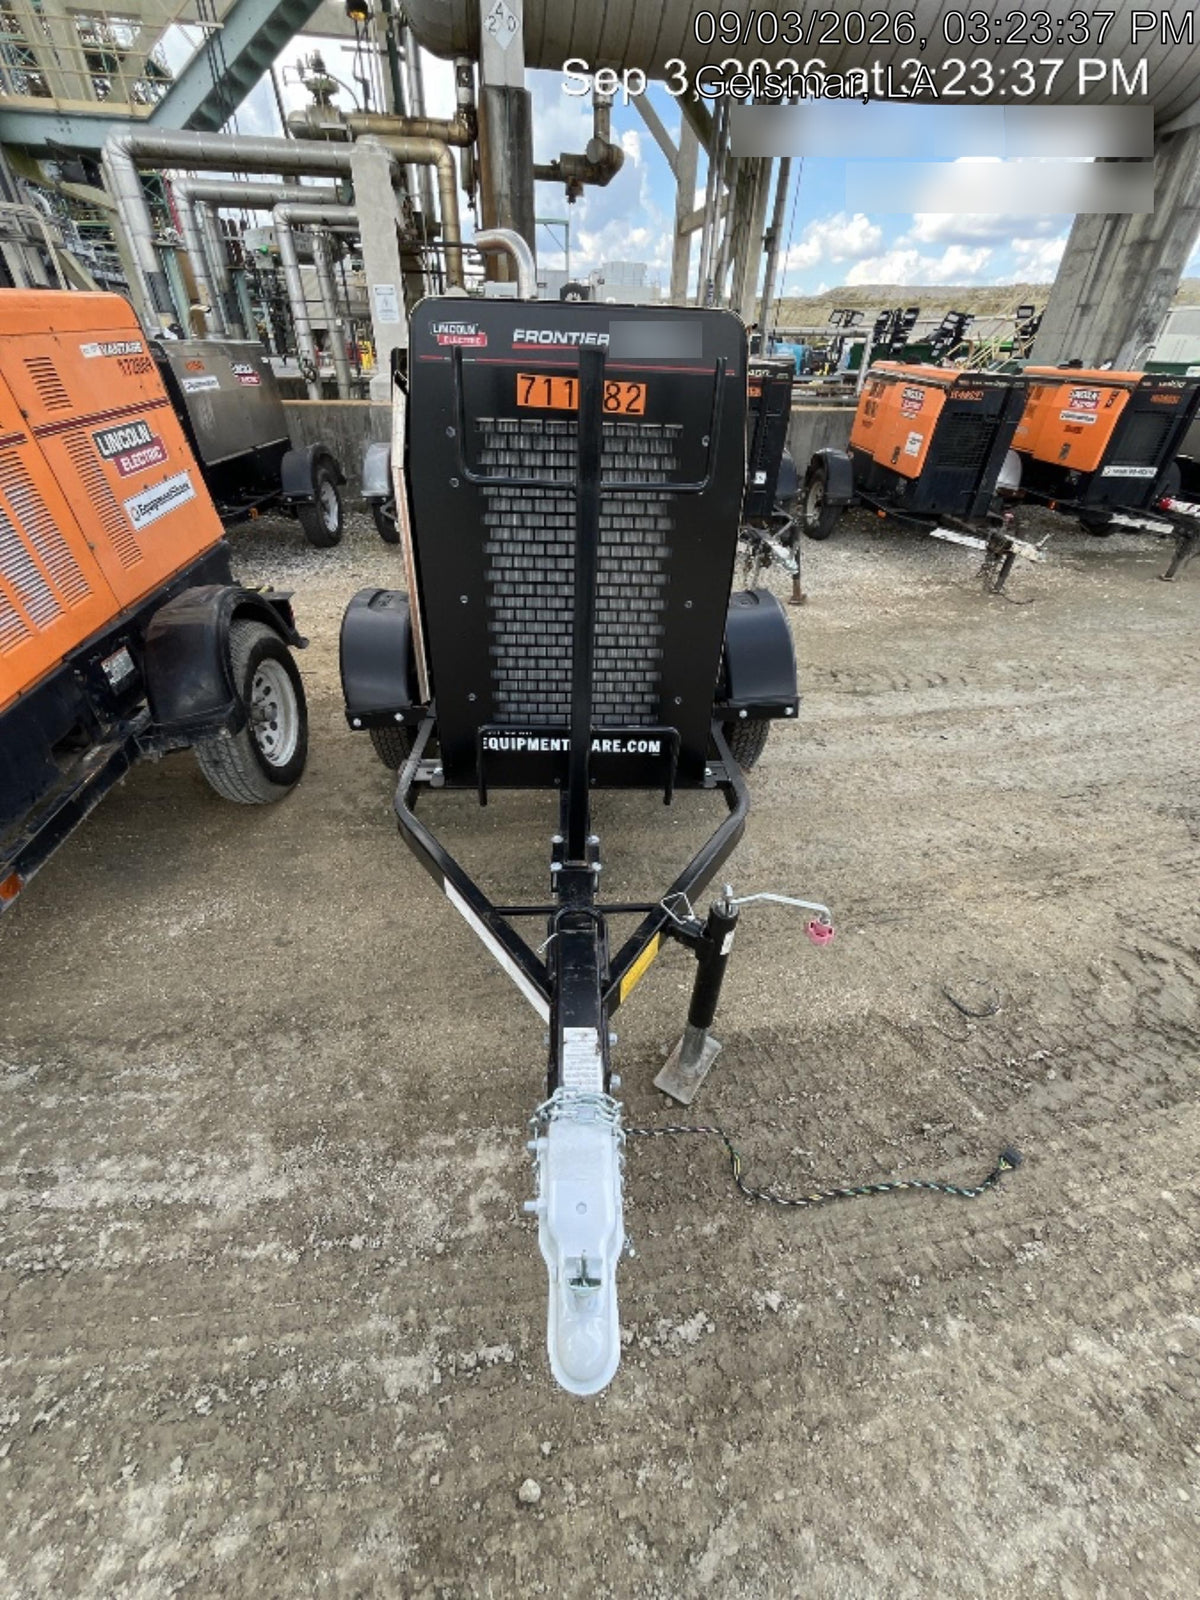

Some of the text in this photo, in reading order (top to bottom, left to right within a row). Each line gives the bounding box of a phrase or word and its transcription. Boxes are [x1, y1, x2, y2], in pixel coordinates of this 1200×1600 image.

[495, 2, 504, 19] 4
[488, 15, 517, 32] 2 0
[431, 322, 476, 335] LINCOLN
[512, 328, 610, 347] FRONTIER
[443, 335, 482, 345] ELECTRIC
[520, 376, 642, 412] 71182
[96, 423, 152, 456] LINCOLN
[119, 445, 163, 472] ELECTRIC
[482, 736, 662, 754] EQUIPMENTARE.COM
